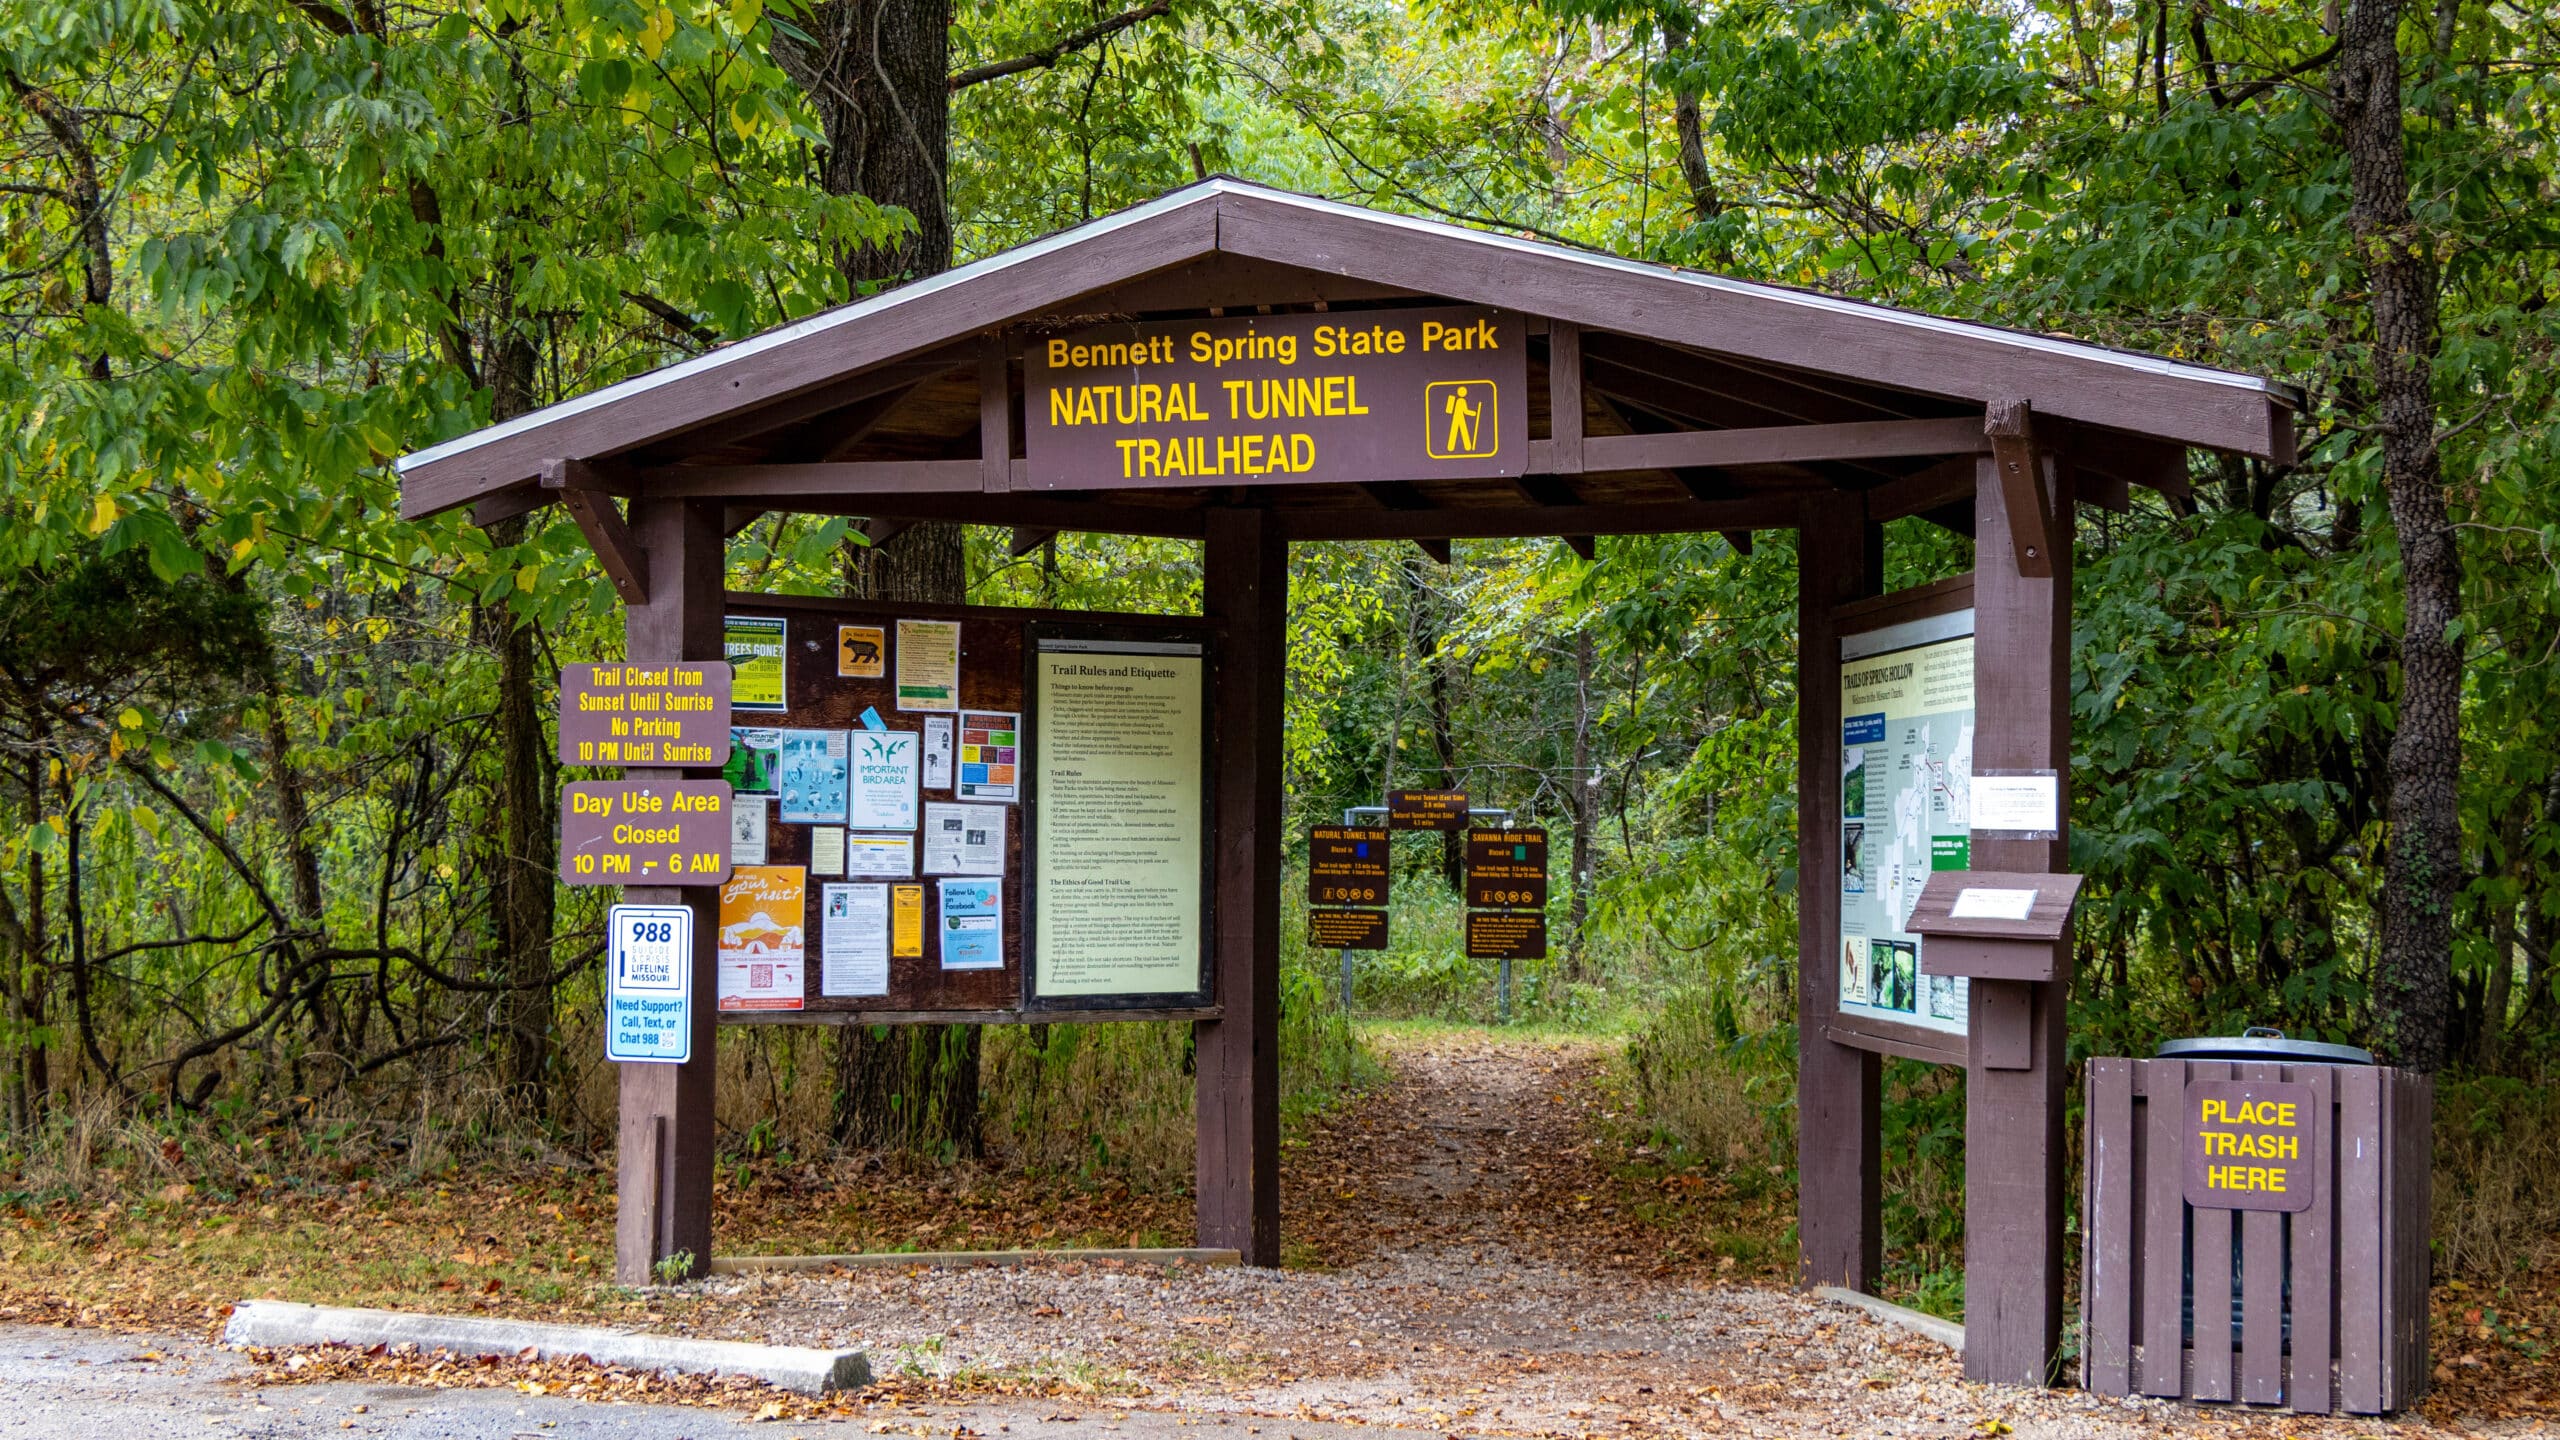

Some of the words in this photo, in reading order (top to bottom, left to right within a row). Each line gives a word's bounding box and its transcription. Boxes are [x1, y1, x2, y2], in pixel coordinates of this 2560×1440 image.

[1049, 336, 1174, 367] Bennett
[1191, 330, 1296, 367] Spring
[1314, 326, 1405, 356] State
[1423, 320, 1498, 351] Park
[1051, 383, 1209, 425] NATURAL
[1223, 376, 1369, 419] TUNNEL
[1116, 434, 1315, 478] TRAILHEAD
[724, 643, 751, 655] TREES
[753, 644, 784, 656] GONE?
[592, 667, 620, 686] Trail
[626, 667, 668, 686] Closed
[674, 668, 702, 686] from
[1050, 664, 1077, 675] Trail
[1079, 665, 1107, 676] Rules
[1109, 667, 1127, 677] and
[1130, 667, 1176, 680] Etiquette
[1844, 672, 1861, 690] TRAILS
[1862, 671, 1868, 686] OF
[1869, 666, 1888, 685] SPRING
[1889, 662, 1914, 681] HOLLOW
[579, 692, 624, 711] Sunset
[630, 692, 660, 711] Until
[665, 692, 713, 711] Sunrise
[611, 718, 628, 736] No
[634, 717, 680, 739] Parking
[579, 742, 593, 761] 10
[598, 742, 618, 760] PM
[624, 742, 654, 761] Until
[663, 742, 711, 762] Sunrise
[860, 765, 909, 774] IMPORTANT
[863, 775, 882, 784] BIRD
[883, 776, 906, 784] AREA
[573, 792, 613, 817] Day
[622, 792, 662, 813] Use
[671, 791, 720, 812] Area
[613, 824, 680, 844] Closed
[1314, 830, 1341, 839] NATURAL
[1343, 831, 1366, 840] TUNNEL
[1368, 831, 1386, 840] TRAIL
[1472, 833, 1502, 842] SAVANNA
[1503, 834, 1523, 842] RIDGE
[1525, 834, 1543, 842] TRAIL
[573, 854, 594, 874] 10
[602, 854, 630, 873] PM
[669, 854, 682, 873] 6
[690, 854, 720, 873] AM
[723, 878, 769, 904] your
[755, 886, 801, 901] visit?
[945, 888, 966, 896] Follow
[945, 902, 976, 910] Facebook
[633, 922, 671, 942] 988
[632, 964, 669, 973] LIFELINE
[632, 974, 669, 982] MISSOURI
[616, 999, 639, 1011] Need
[641, 1000, 682, 1014] Support?
[622, 1016, 641, 1028] Call,
[643, 1017, 664, 1029] Text,
[620, 1032, 640, 1044] Chat
[642, 1034, 659, 1044] 988
[2202, 1099, 2296, 1127] PLACE
[2200, 1132, 2298, 1159] TRASH
[2208, 1165, 2286, 1192] HERE
